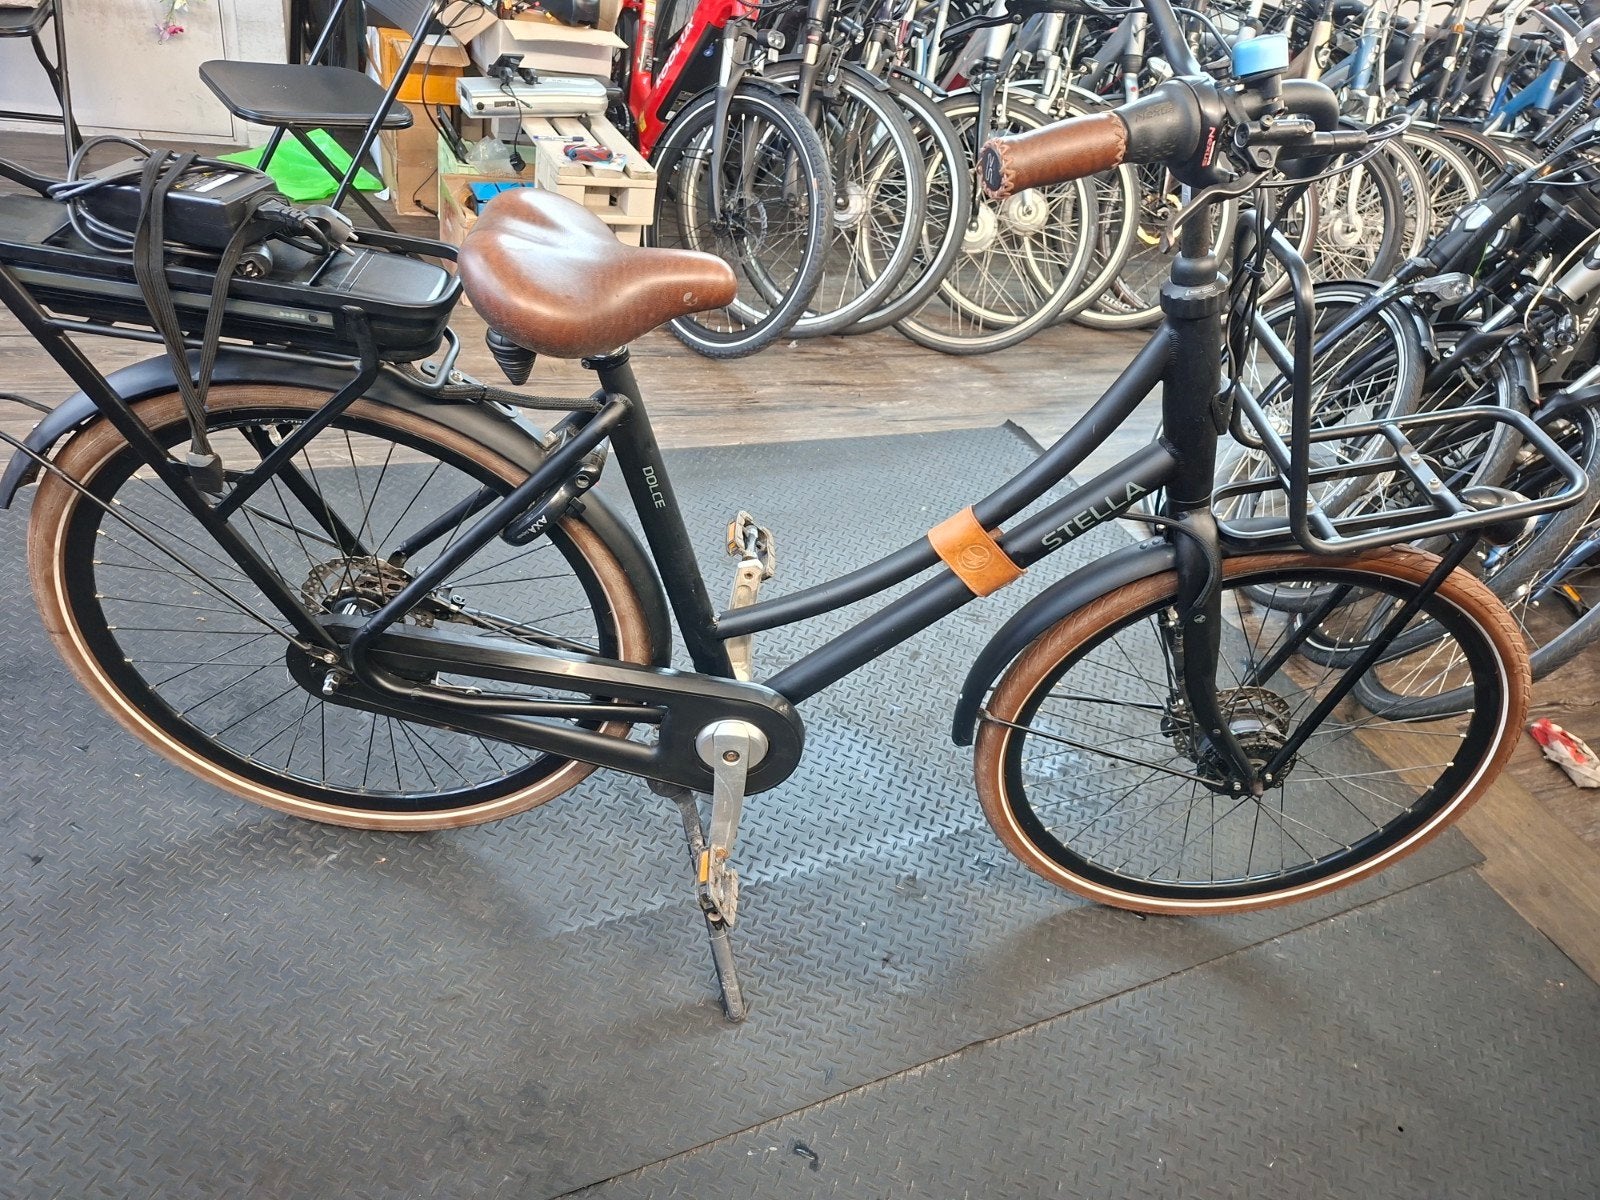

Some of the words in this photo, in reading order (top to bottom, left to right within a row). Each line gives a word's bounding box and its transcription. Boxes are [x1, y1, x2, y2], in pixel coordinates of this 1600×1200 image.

[642, 465, 666, 509] DOLCE
[528, 514, 548, 533] AXA
[1041, 481, 1147, 550] STELLA
